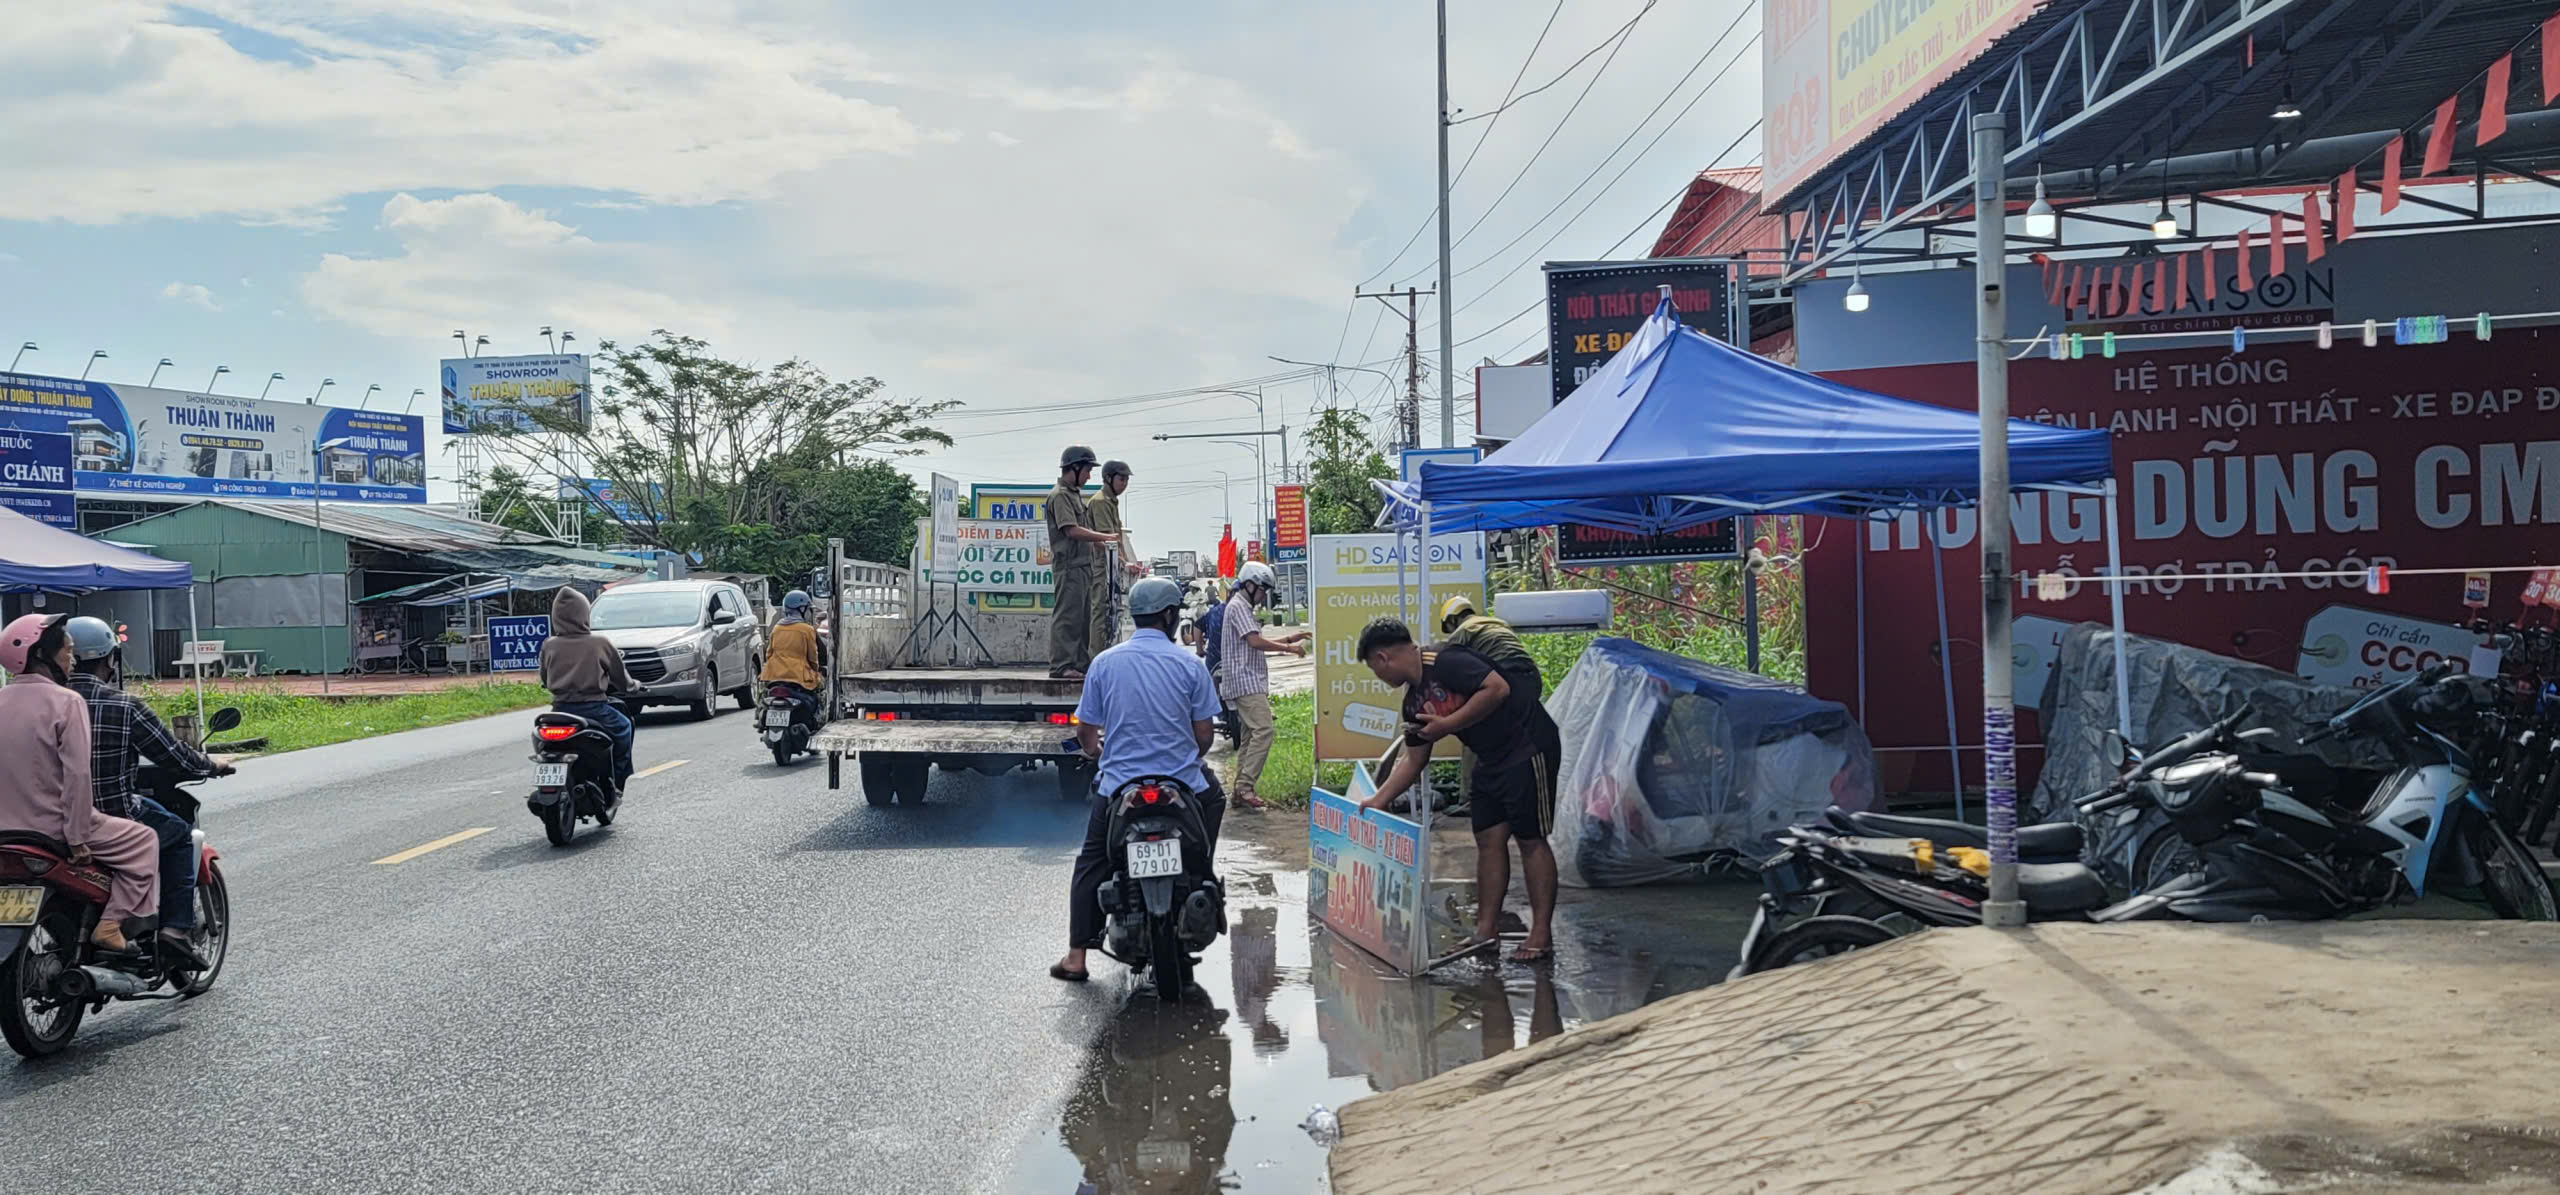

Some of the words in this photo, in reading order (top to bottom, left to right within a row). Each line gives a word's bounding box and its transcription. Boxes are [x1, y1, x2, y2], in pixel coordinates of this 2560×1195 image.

[1574, 334, 1601, 353] XE
[486, 368, 559, 380] SHOWROOM
[2115, 361, 2158, 394] HỆ
[2168, 352, 2288, 388] THỐNG
[2268, 388, 2359, 425] THẤT
[2392, 393, 2438, 418] XE
[2450, 388, 2524, 419] ĐẠP
[165, 405, 220, 432] THUẬN
[225, 409, 275, 433] THÀNH
[0, 432, 32, 450] HUỐC
[3, 459, 65, 483] CHÁNH
[2132, 438, 2379, 541] DŨNG
[994, 525, 1031, 540] BÁN:
[993, 547, 1030, 564] ZEO
[1279, 549, 1299, 559] BIDV
[1336, 547, 1367, 565] HD
[989, 560, 1015, 585] CÁ
[2092, 559, 2185, 600] TRỢ
[2196, 548, 2286, 593] TRẢ
[1327, 592, 1358, 608] CỬA
[1360, 590, 1400, 607] HÀNG
[491, 618, 547, 638] THUỐC
[2365, 621, 2396, 638] Chỉ
[2399, 627, 2432, 646] cần
[500, 638, 539, 654] TÂY
[1331, 672, 1356, 695] HỖ
[1359, 715, 1393, 732] THẤP
